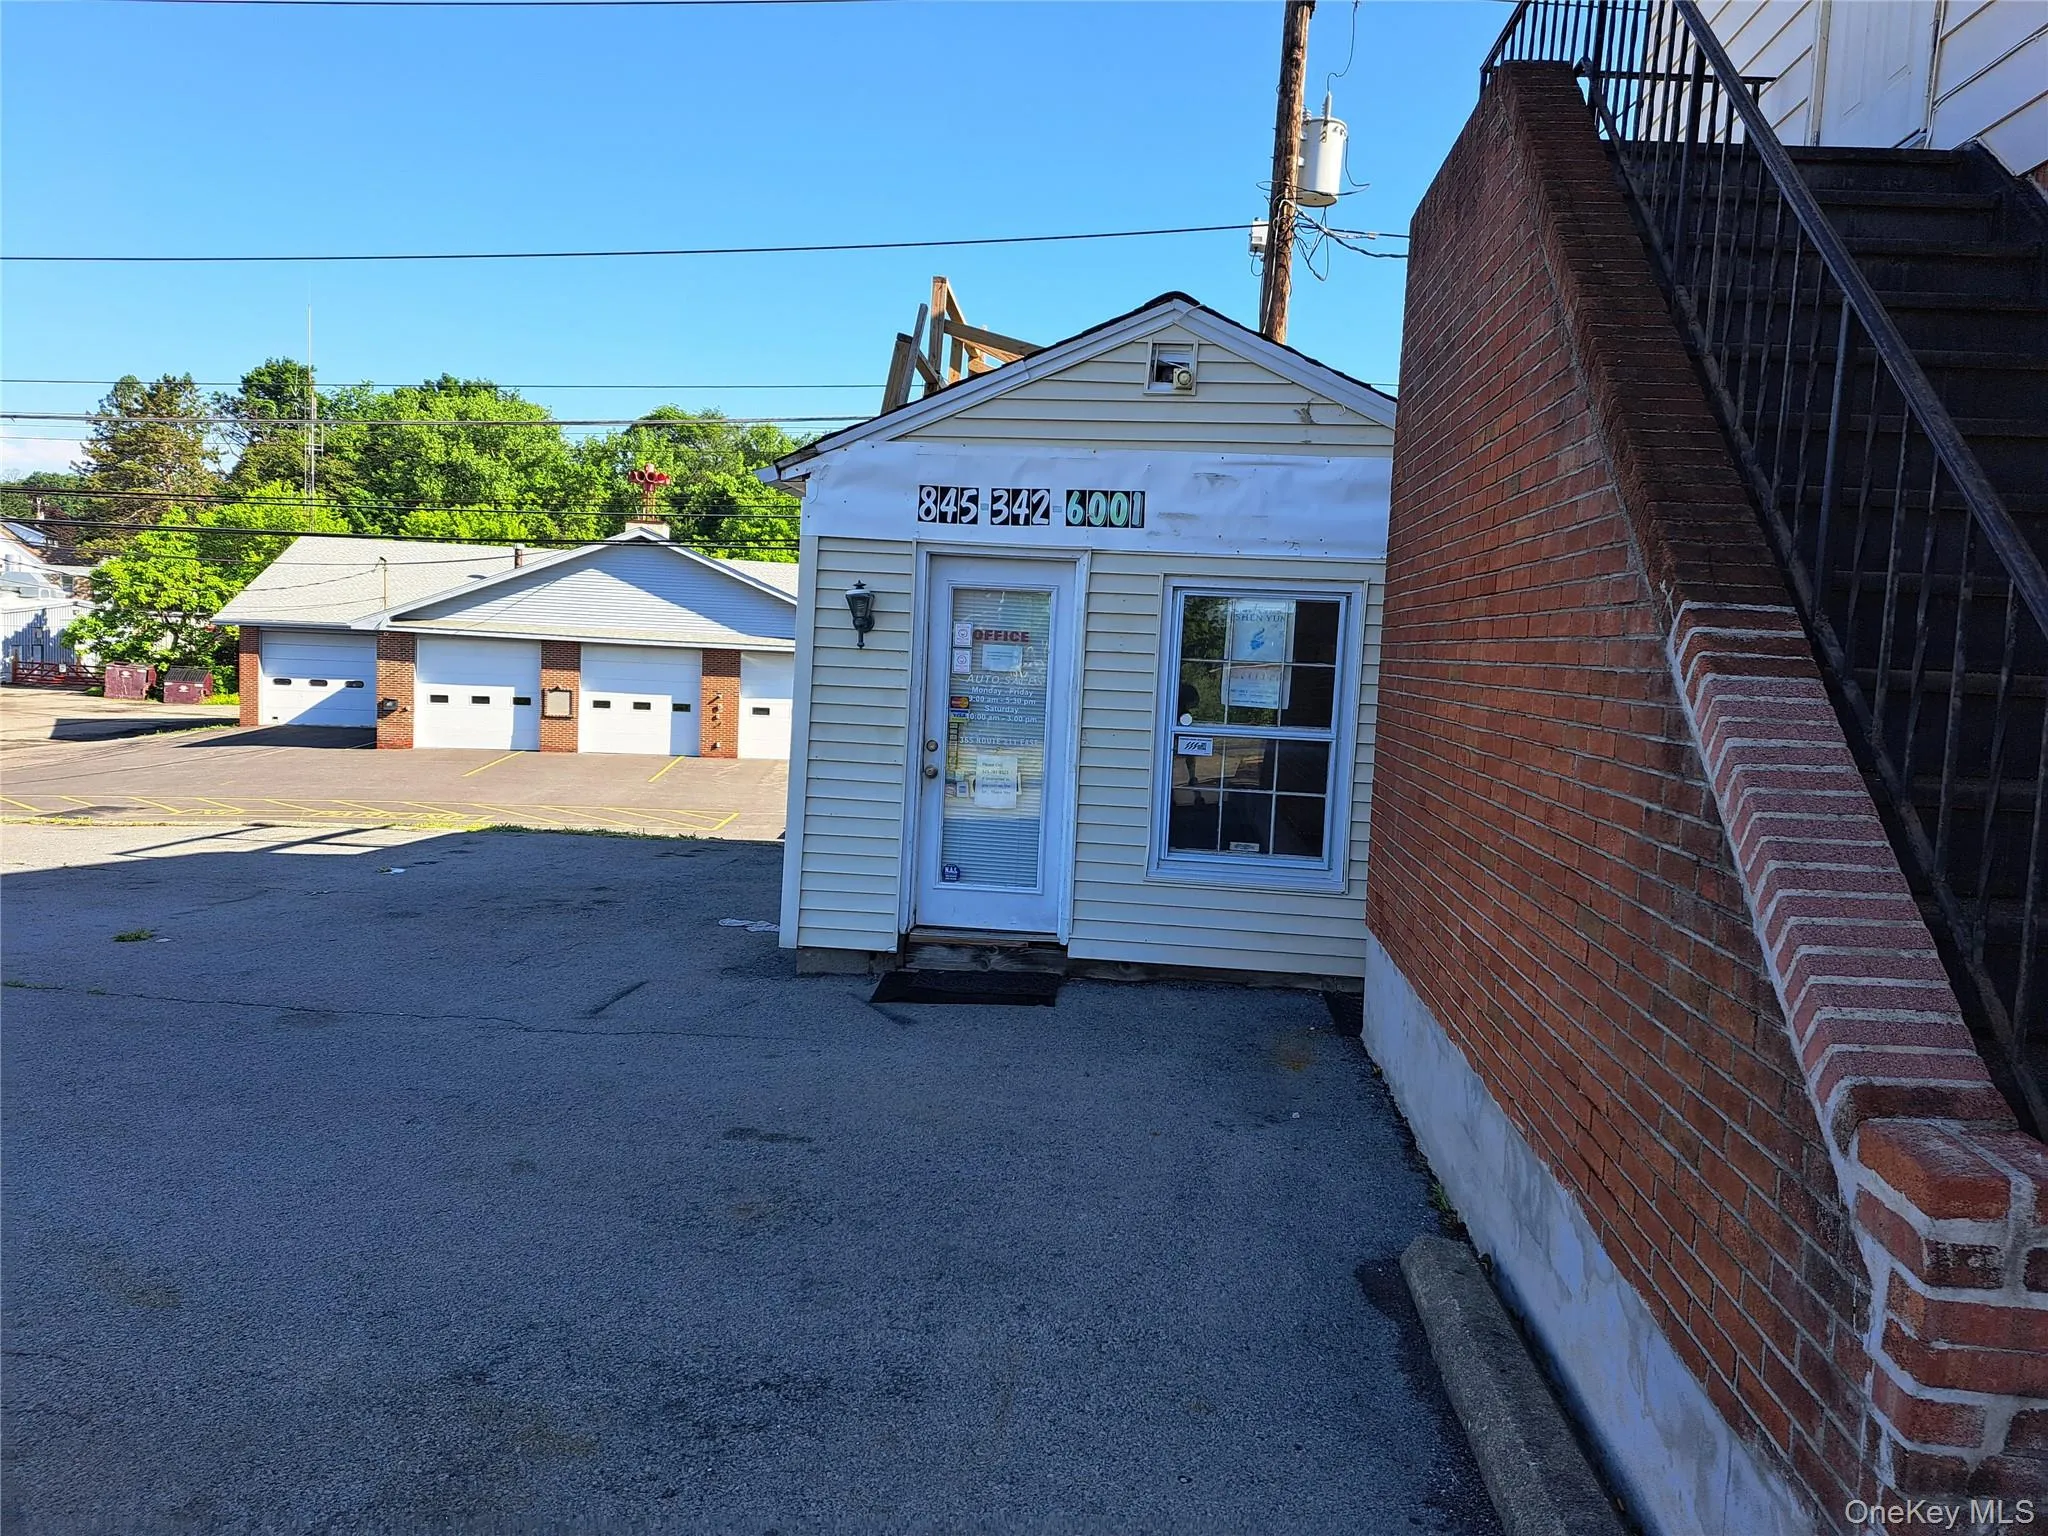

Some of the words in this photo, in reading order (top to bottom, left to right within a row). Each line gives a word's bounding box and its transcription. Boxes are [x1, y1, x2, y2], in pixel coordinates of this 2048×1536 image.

[918, 486, 978, 523] 845
[991, 488, 1049, 525] 342
[1066, 491, 1144, 527] 6001
[973, 629, 1029, 642] OFFICE
[966, 674, 1000, 684] AUTO
[972, 687, 1001, 696] Monday
[1009, 689, 1033, 697] Friday
[984, 705, 1019, 714] Saturday
[976, 737, 1000, 745] ROUTE
